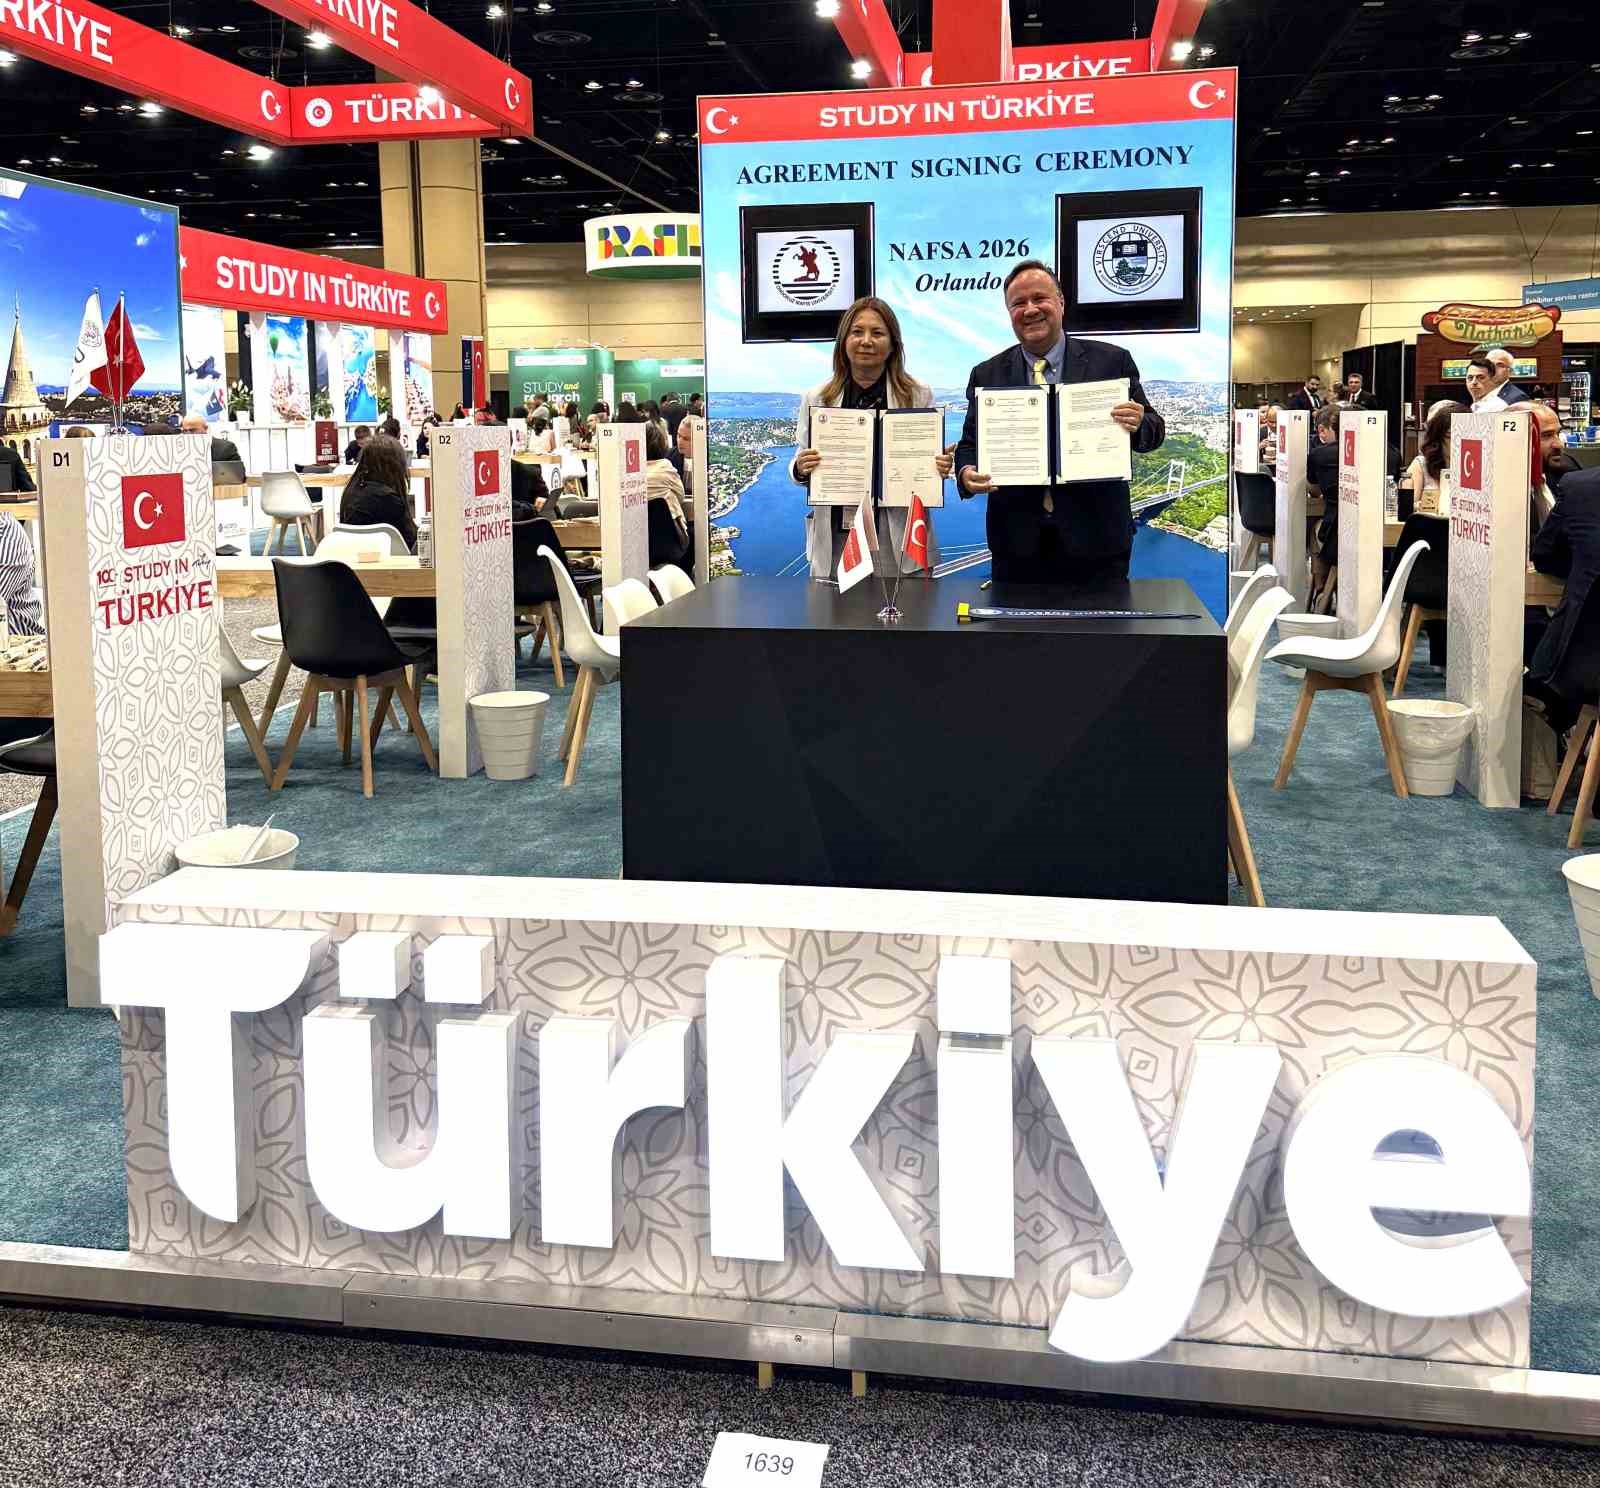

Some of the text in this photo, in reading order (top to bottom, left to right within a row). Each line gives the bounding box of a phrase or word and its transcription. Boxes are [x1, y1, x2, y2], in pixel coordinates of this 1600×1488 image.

[819, 89, 1095, 128] STUDY IN TÜRKİYE
[737, 145, 1194, 185] AGREEMENT SIGNING CEREMONY
[597, 223, 701, 260] BRASIL
[888, 237, 1030, 262] NAFSA 2026
[1133, 225, 1165, 264] UNIVERSITY
[216, 255, 411, 317] STUDY IN TÜRKİYE
[915, 271, 1001, 293] Orlando
[1455, 318, 1535, 342] Nathan's
[523, 381, 580, 394] STUDY and
[603, 429, 613, 437] D3
[1367, 417, 1377, 425] F3
[1503, 421, 1516, 432] F2
[439, 435, 451, 445] D2
[53, 452, 70, 467] D1
[475, 504, 494, 517] STUDY
[465, 518, 511, 545] TÜRKİYE
[1451, 515, 1491, 545] TÜRKİYE
[124, 560, 172, 583] STUDY
[174, 557, 189, 574] IN
[98, 579, 213, 629] TÜRKİYE
[99, 925, 1534, 1363] Türkiye
[744, 1452, 795, 1476] 1639
